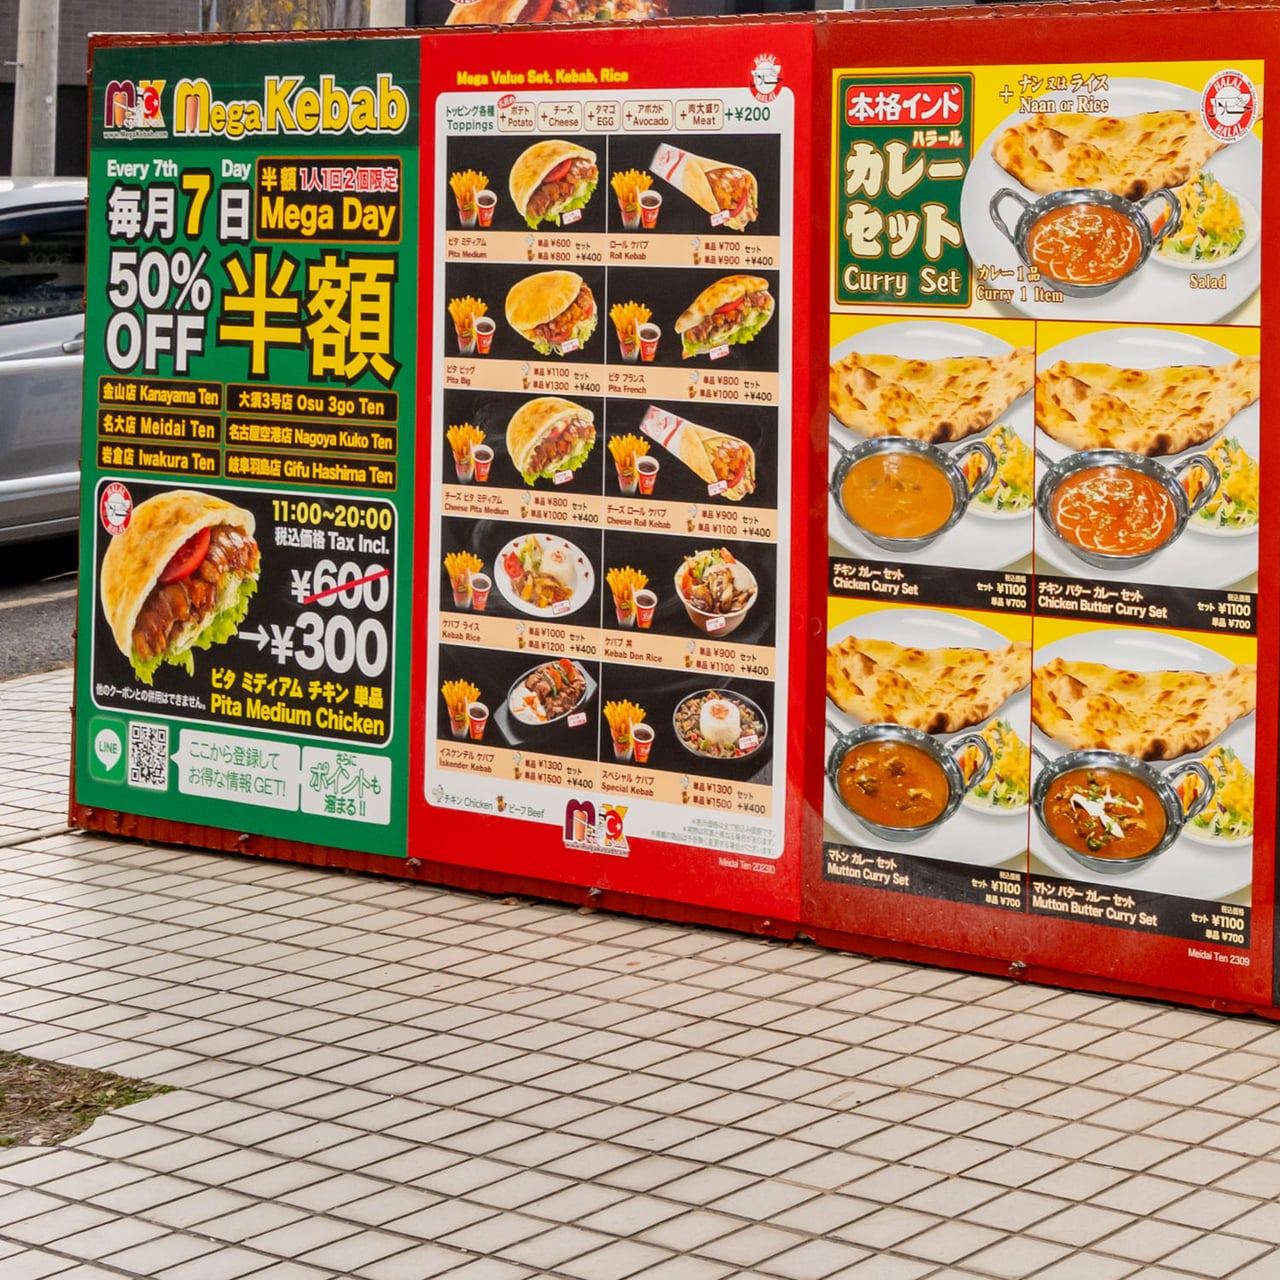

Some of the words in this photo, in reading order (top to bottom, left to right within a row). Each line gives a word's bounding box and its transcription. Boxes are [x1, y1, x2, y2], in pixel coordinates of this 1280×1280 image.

[457, 71, 488, 86] Mega
[491, 70, 525, 84] Value
[528, 70, 552, 86] Set,
[556, 69, 597, 84] Kebab,
[600, 68, 628, 82] Rice
[1019, 76, 1045, 91] ナン
[1047, 79, 1066, 91] 又は
[1071, 75, 1109, 91] ライス
[1214, 77, 1242, 92] HALAL
[263, 73, 409, 135] Kebab
[446, 105, 495, 118] トッピング各種
[848, 90, 960, 122] 本格インド
[1020, 97, 1055, 113] Naan
[1060, 101, 1074, 113] or
[1077, 96, 1109, 113] Rice
[447, 119, 494, 132] Toppings
[507, 117, 533, 128] Potato
[549, 116, 578, 127] Cheese
[597, 116, 614, 126] EGG
[633, 116, 669, 127] Avocado
[693, 115, 716, 126] Meat
[912, 130, 962, 148] ハラール
[108, 160, 149, 179] Every
[154, 160, 177, 177] 7th
[222, 160, 251, 180] Day
[846, 140, 963, 197] カレー
[261, 197, 333, 235] Mega
[343, 199, 396, 237] Day
[845, 202, 961, 259] セット
[624, 252, 646, 260] Kebab
[109, 251, 212, 310] 50%
[843, 265, 907, 297] Curry
[920, 270, 960, 295] Set
[1189, 274, 1226, 289] Salad
[219, 252, 399, 381] 半額
[107, 313, 205, 372] OFF
[103, 383, 137, 402] 金山店
[140, 384, 196, 407] Kanayama
[199, 389, 218, 406] Ten
[608, 385, 622, 394] Pita
[624, 385, 646, 395] French
[297, 394, 323, 411] Osu
[328, 396, 355, 414] 3go
[359, 398, 384, 416] Ten
[104, 416, 136, 434] 名大店
[140, 417, 186, 438] Meidai
[190, 420, 215, 439] Ten
[294, 428, 336, 448] Nagoya
[339, 431, 369, 448] Kuko
[372, 434, 392, 450] Ten
[102, 447, 134, 466] 岩倉店
[139, 449, 188, 469] Iwakura
[191, 453, 215, 470] Ten
[275, 527, 325, 550] 税込価格
[328, 532, 354, 552] Tax
[358, 535, 390, 554] Incl.
[291, 560, 390, 612] ¥600
[833, 578, 870, 591] Chicken
[872, 582, 900, 595] Curry
[901, 583, 918, 596] Set
[997, 584, 1026, 596] ¥1100
[1038, 595, 1078, 610] Chicken
[1080, 599, 1113, 613] Butter
[1115, 603, 1146, 618] Curry
[1149, 605, 1167, 618] Set
[1218, 603, 1250, 616] ¥1100
[271, 611, 388, 677] ¥300
[242, 672, 303, 699] ミディアム
[309, 681, 349, 704] チキン
[354, 686, 384, 710] 単品
[211, 694, 242, 717] Pita
[246, 697, 311, 726] Medium
[316, 707, 384, 736] Chicken
[99, 741, 117, 754] LINE
[190, 741, 280, 770] ここから登録して
